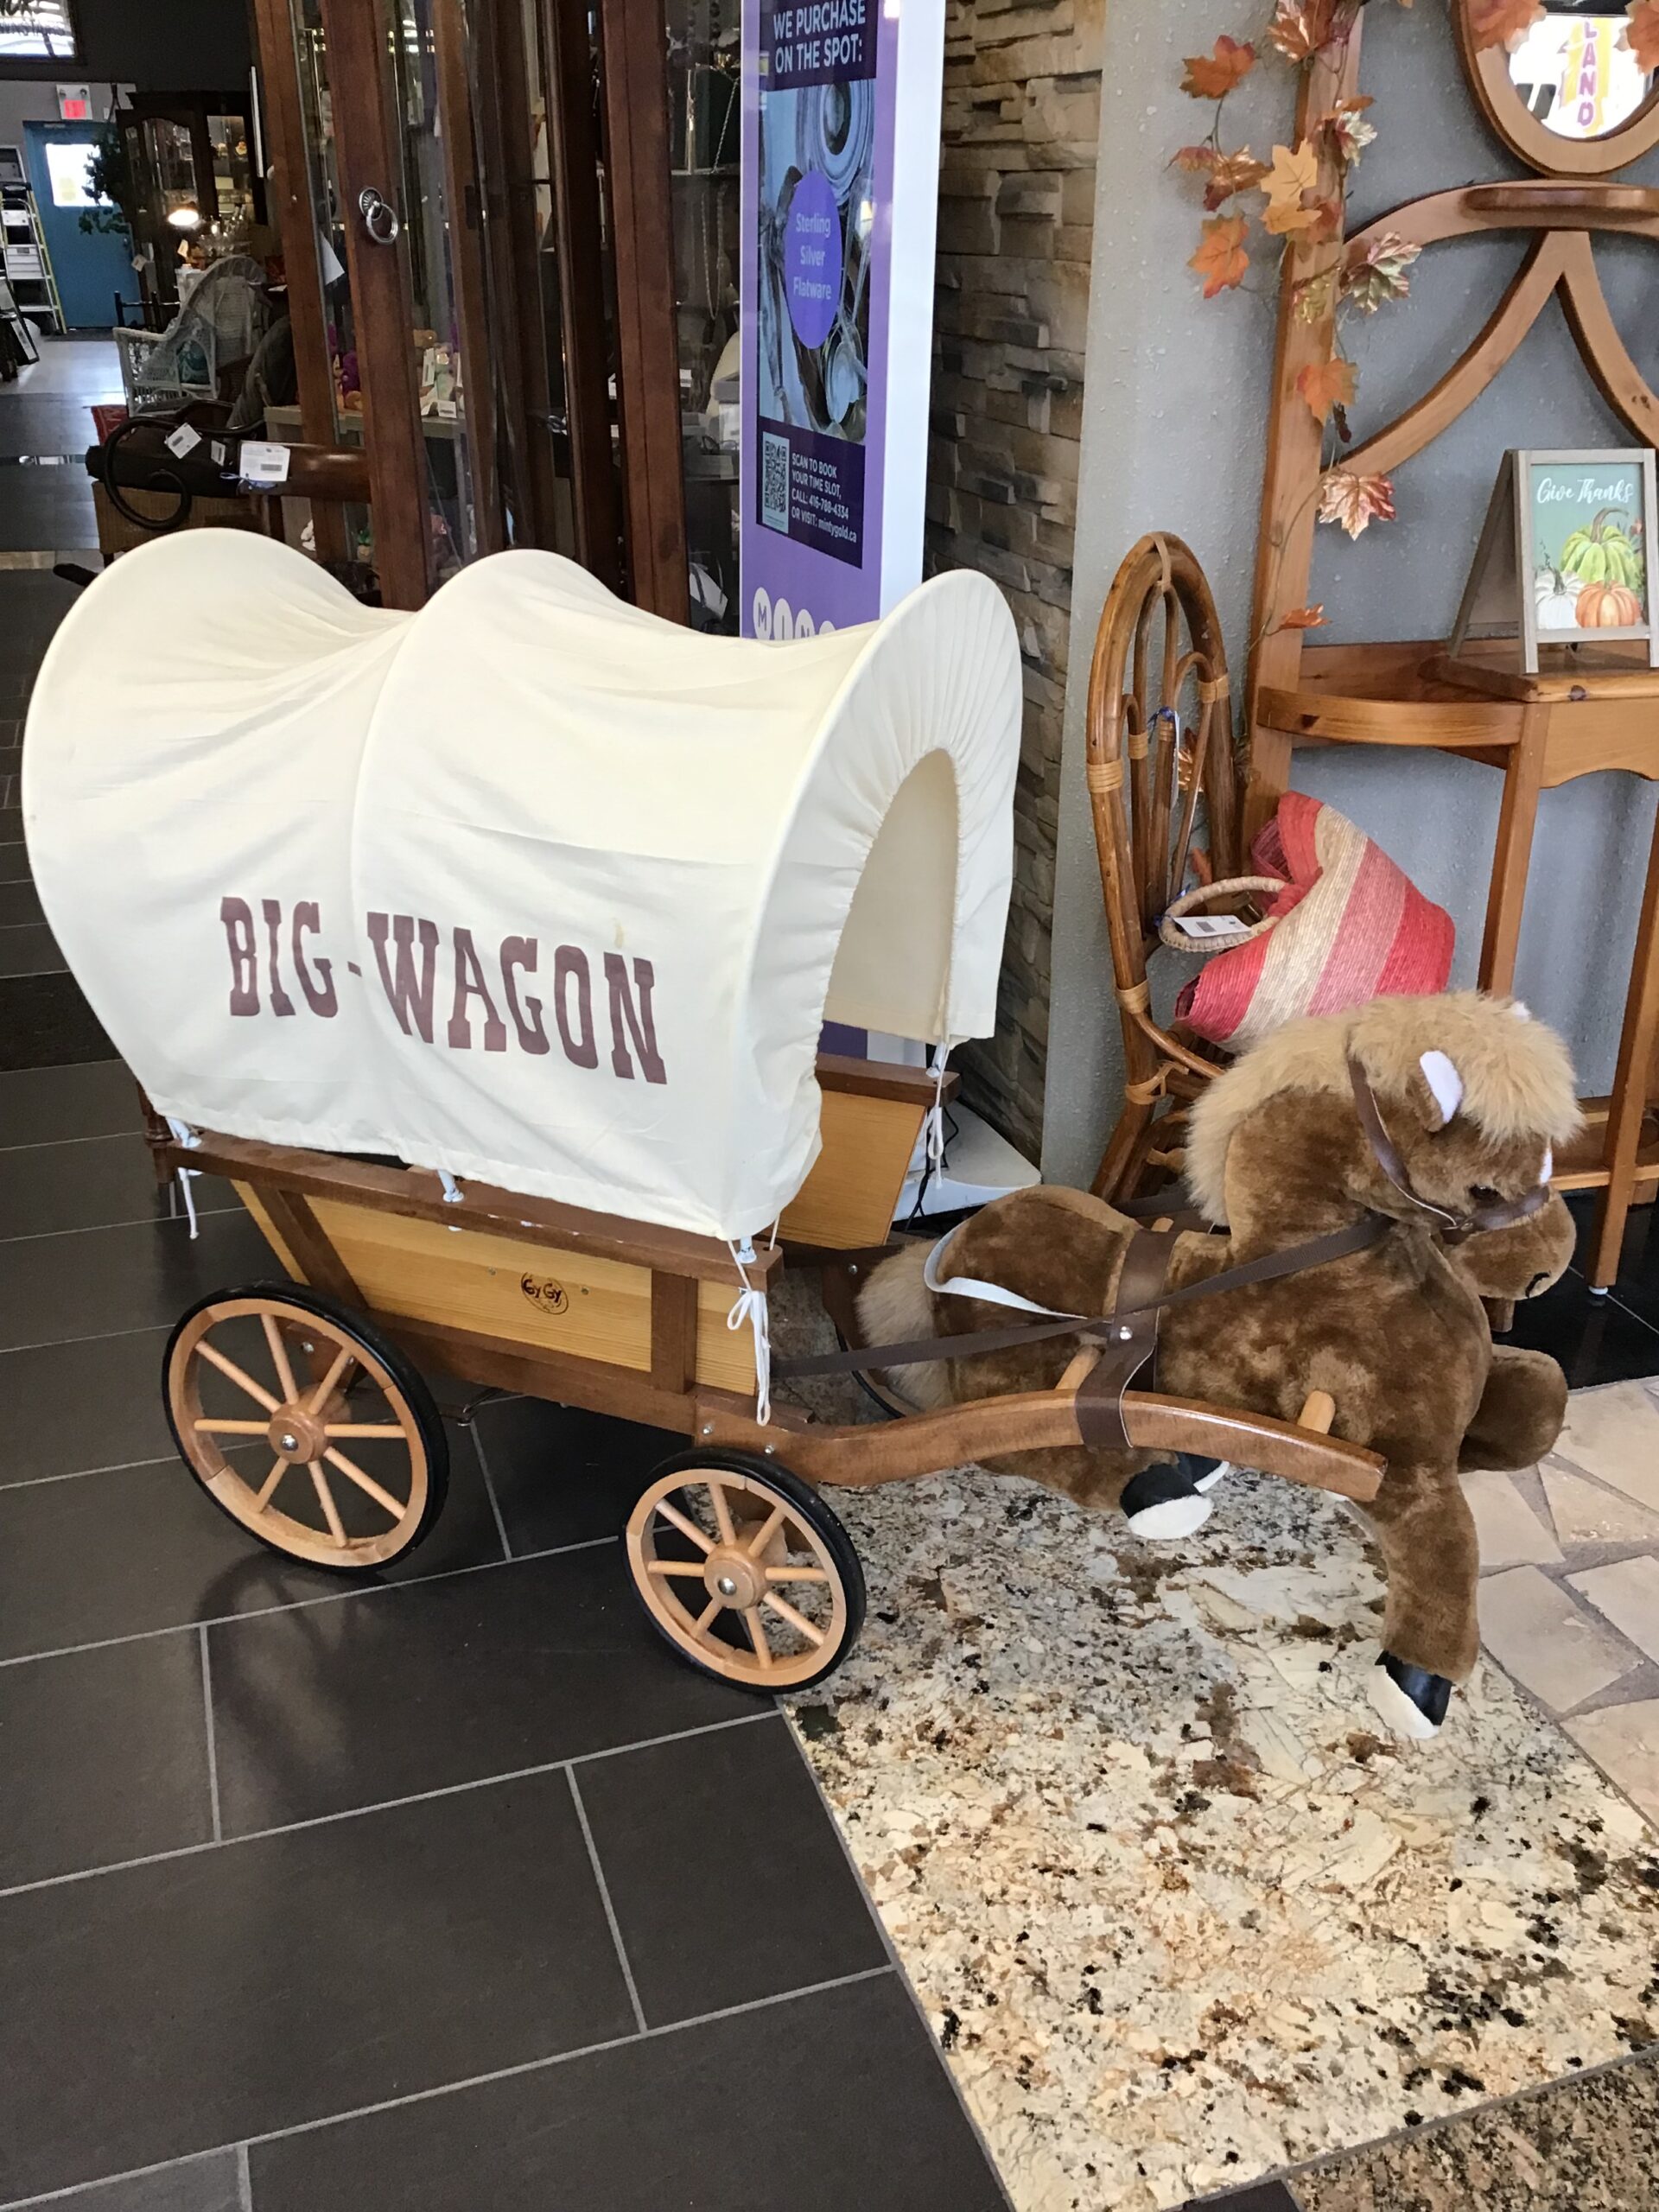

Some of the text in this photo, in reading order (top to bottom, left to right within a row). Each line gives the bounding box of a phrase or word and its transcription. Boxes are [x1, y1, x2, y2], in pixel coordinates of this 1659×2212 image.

[773, 0, 866, 40] WE PURCHASE
[775, 33, 863, 73] ON THE SPOT:
[796, 213, 831, 238] Sterling
[800, 245, 826, 267] Silver
[793, 276, 832, 300] Flatware
[791, 452, 836, 479] SCAN TO BOOK
[791, 468, 808, 486] YOUR
[809, 474, 823, 492] TIME
[1536, 477, 1634, 504] Give Thanks
[791, 505, 800, 521] OR
